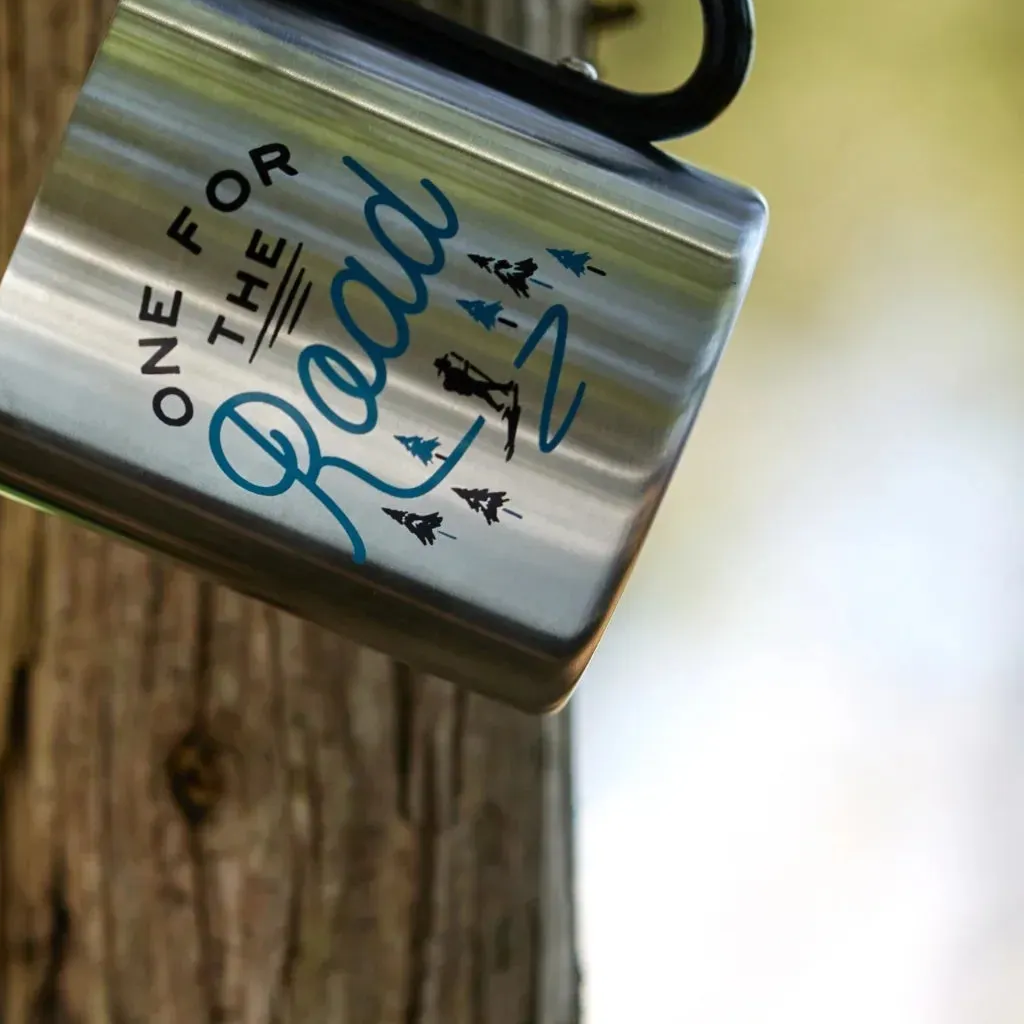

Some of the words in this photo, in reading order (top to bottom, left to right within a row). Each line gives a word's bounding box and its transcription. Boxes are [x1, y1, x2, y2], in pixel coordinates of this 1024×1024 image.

[138, 285, 194, 427] ONE
[166, 142, 298, 256] FOR
[207, 228, 287, 345] THE
[208, 155, 485, 564] Road
